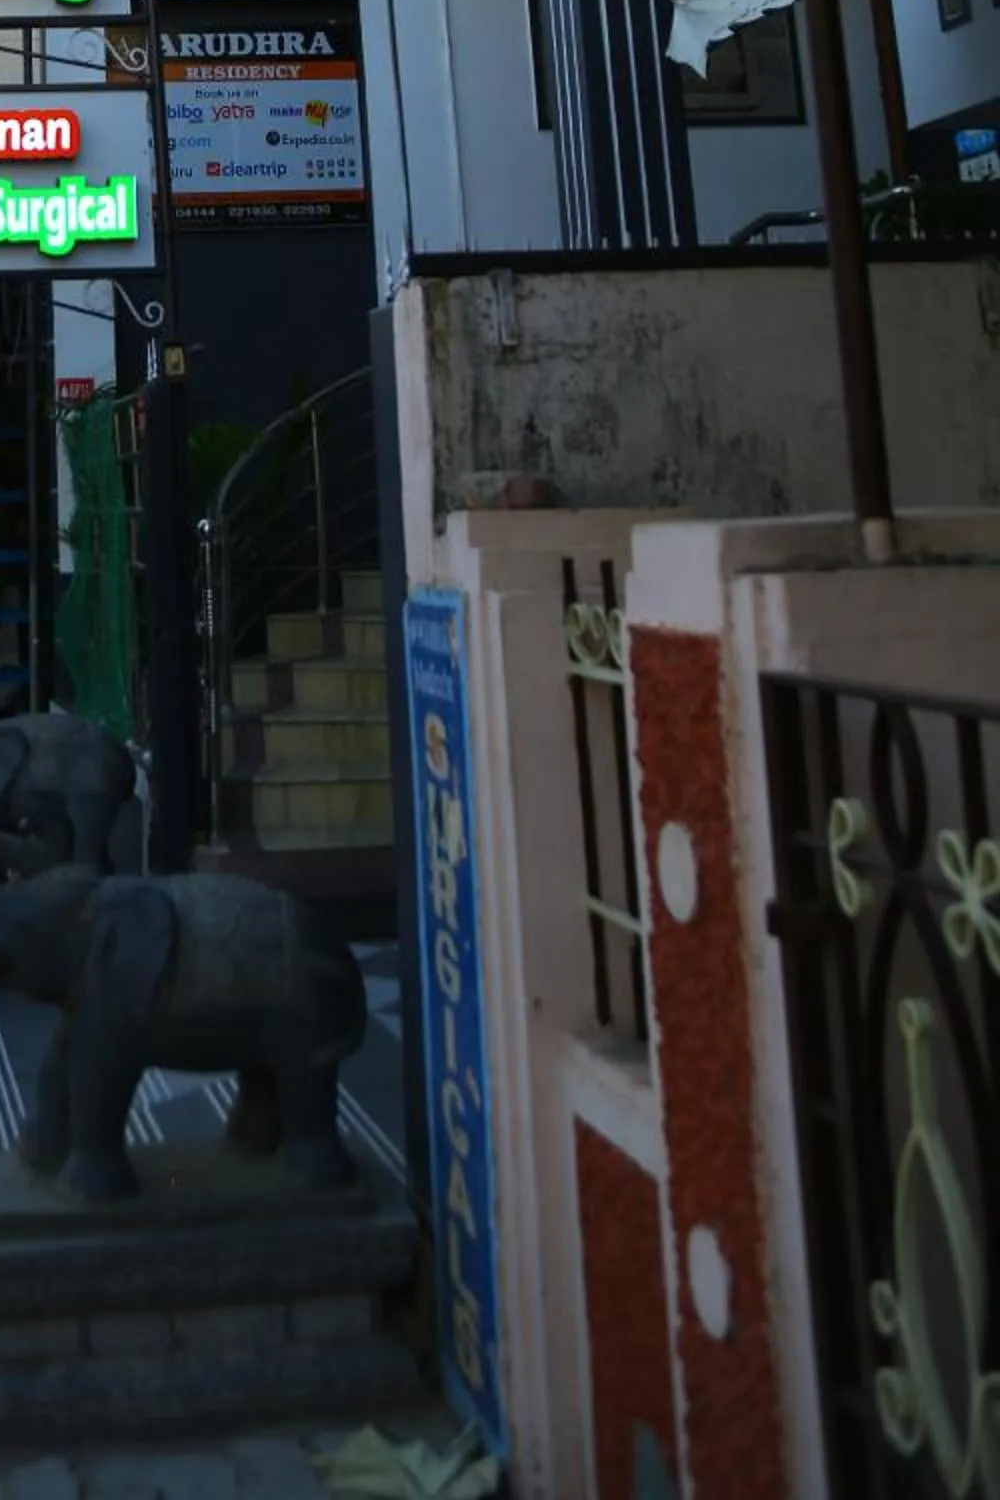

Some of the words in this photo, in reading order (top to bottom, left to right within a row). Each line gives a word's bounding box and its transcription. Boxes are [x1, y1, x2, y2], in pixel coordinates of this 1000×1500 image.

[160, 31, 335, 57] ARUDHRA
[186, 64, 302, 80] RESIDENCY
[212, 102, 255, 121] yatra
[222, 161, 287, 179] cleartrip
